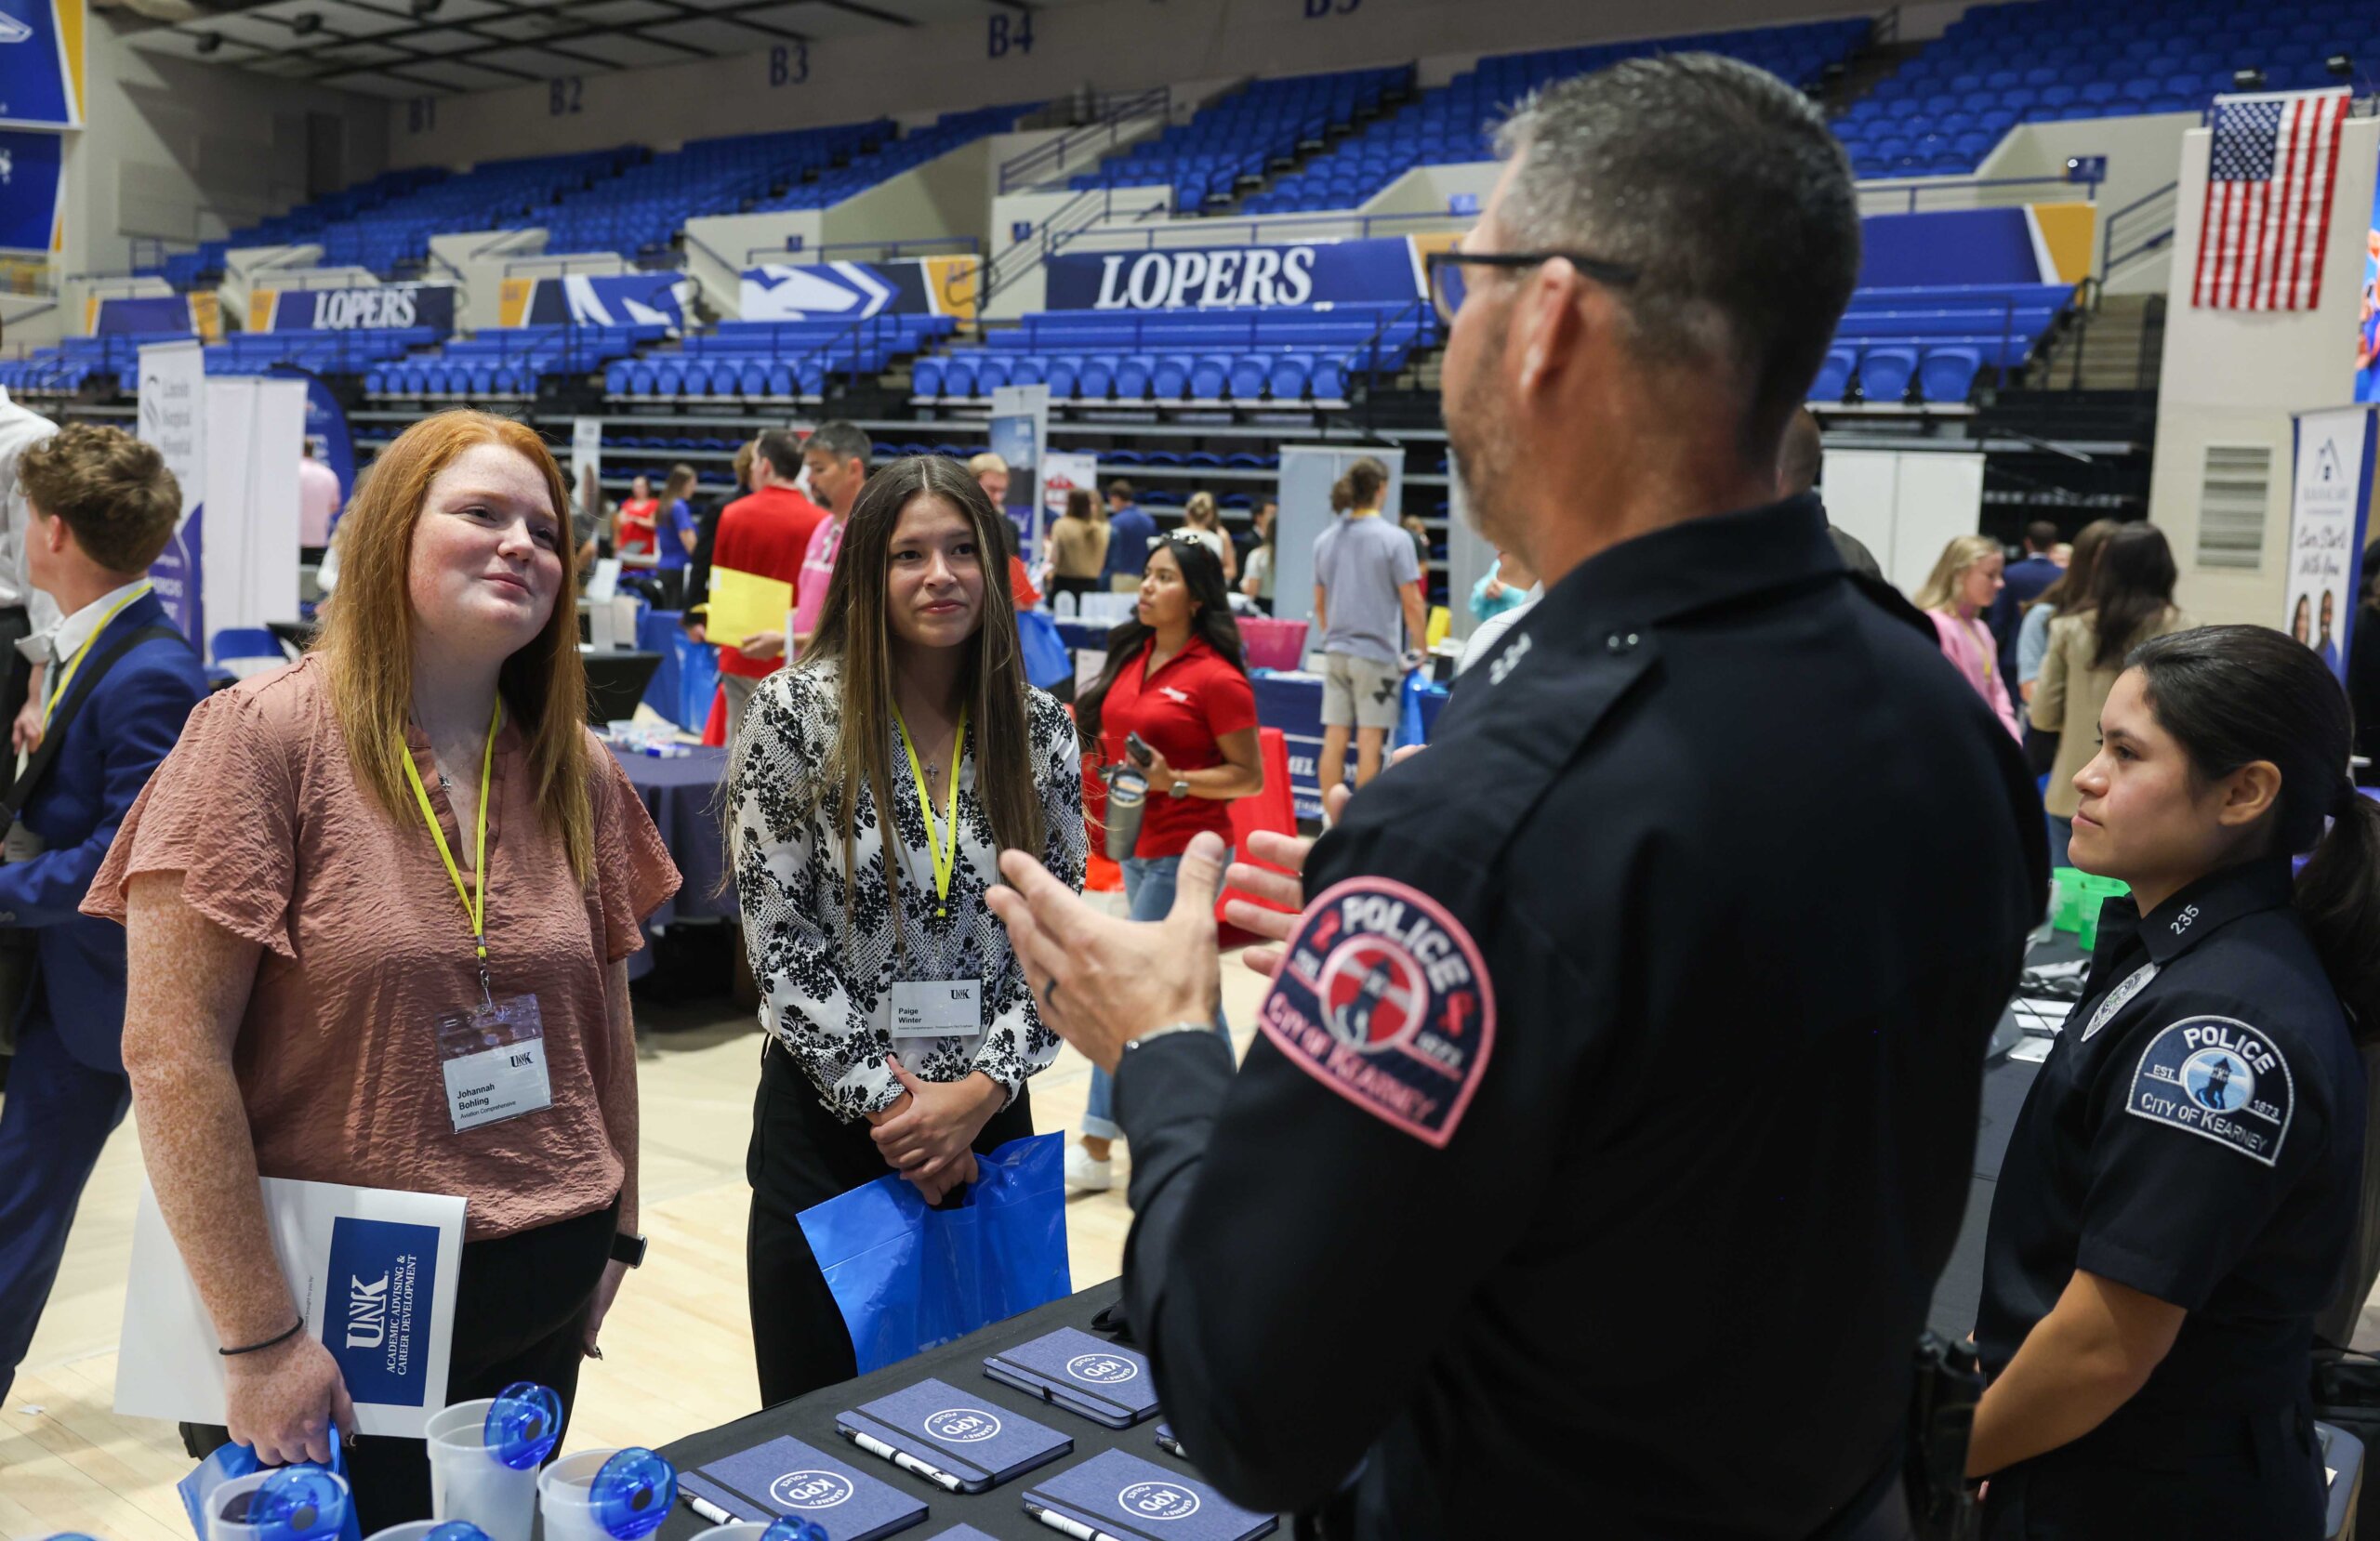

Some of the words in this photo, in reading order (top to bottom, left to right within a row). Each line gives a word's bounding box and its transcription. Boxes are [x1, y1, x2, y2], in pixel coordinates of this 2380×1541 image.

[987, 10, 1035, 59] B4
[769, 43, 810, 87] B3
[549, 75, 583, 116] B2
[409, 96, 436, 133] B1
[1092, 246, 1316, 310] LOPERS
[311, 288, 417, 330] LOPERS
[2170, 903, 2200, 935] 235
[1342, 895, 1471, 994] POLICE
[950, 988, 971, 1000] UNK
[898, 1008, 919, 1016] Paige
[509, 1051, 534, 1068] UNK
[2183, 1025, 2276, 1075] POLICE
[456, 1083, 496, 1100] Johannah
[2152, 1064, 2175, 1080] EST.
[2253, 1099, 2280, 1119] 1873
[458, 1097, 490, 1111] Bohling
[460, 1110, 480, 1120] Aviation
[480, 1100, 517, 1114] Comprehensive
[397, 1255, 405, 1263] &
[390, 1266, 404, 1316] ADVISING
[401, 1254, 416, 1333] DEVELOPMENT
[346, 1274, 390, 1349] UNK
[386, 1318, 400, 1373] ACADEMIC
[397, 1335, 410, 1376] CAREER
[1074, 1357, 1096, 1367] POLICE
[1083, 1360, 1122, 1376] KPD
[1104, 1367, 1130, 1381] KEARNEY
[932, 1412, 958, 1424] POLICE
[942, 1416, 985, 1435] KPD
[962, 1425, 993, 1440] KEARNEY
[780, 1474, 809, 1487] POLICE
[788, 1478, 836, 1500] KPD
[809, 1489, 845, 1506] KEARNEY
[1127, 1485, 1151, 1499] POLICE
[1138, 1489, 1182, 1511] KPD
[1162, 1499, 1192, 1516] KEARNEY
